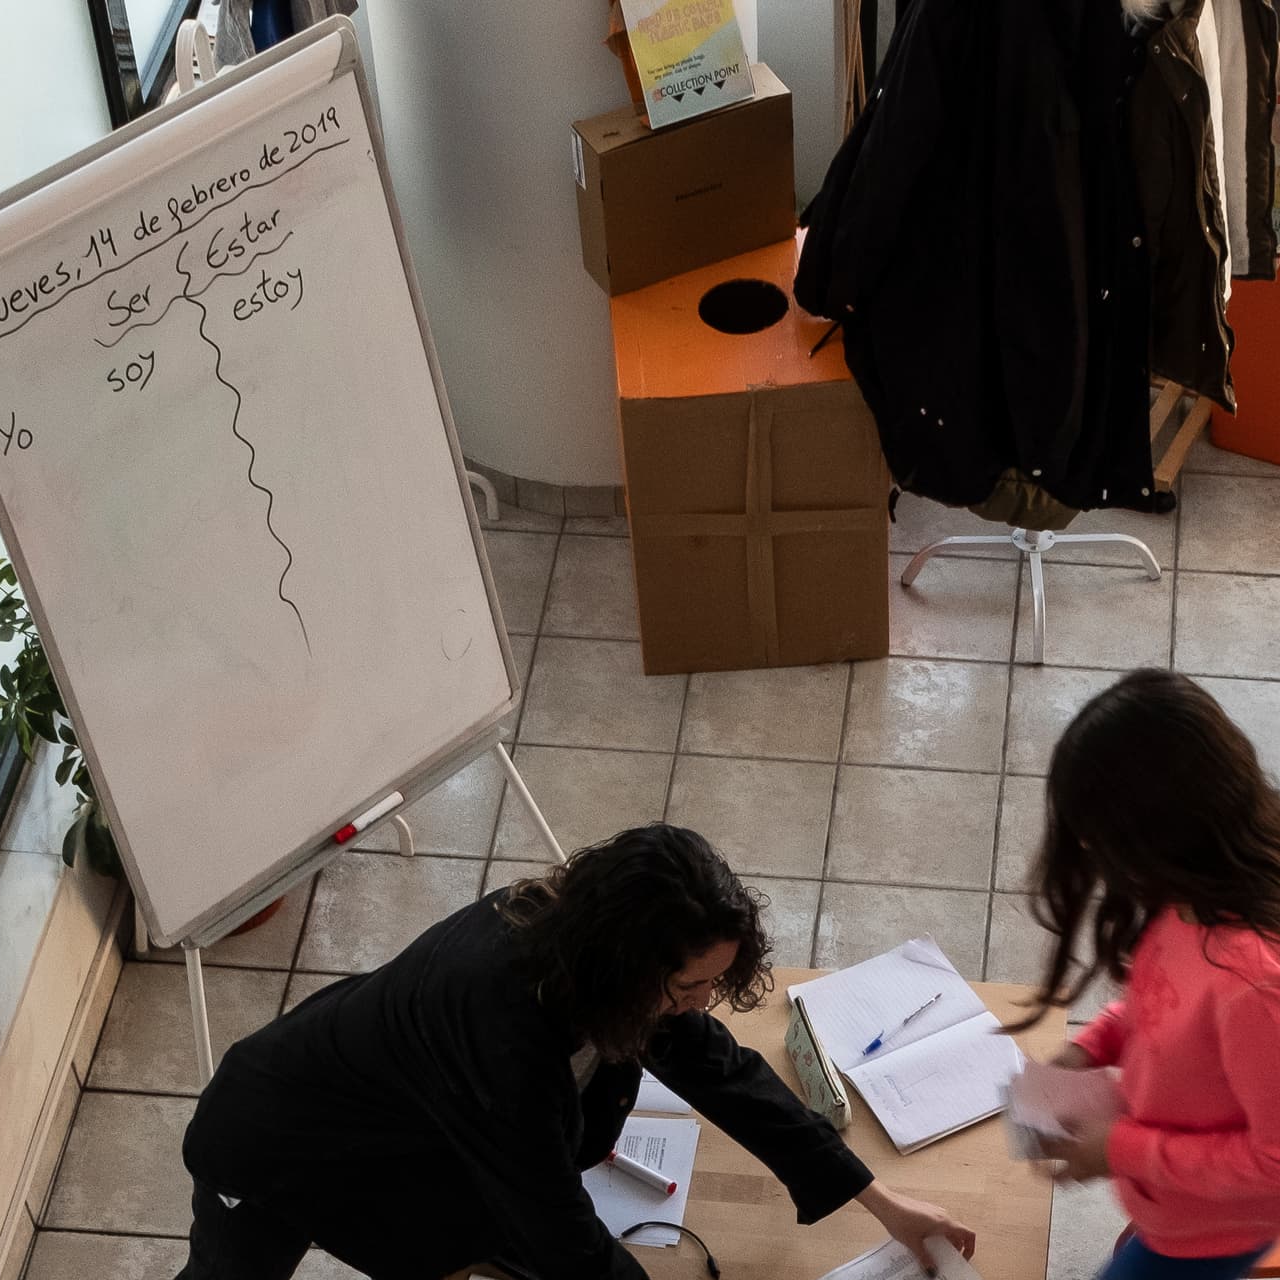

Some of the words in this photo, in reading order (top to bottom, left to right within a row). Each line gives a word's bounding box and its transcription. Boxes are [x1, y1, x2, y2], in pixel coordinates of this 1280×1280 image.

[660, 71, 712, 98] COLLECTION
[714, 64, 740, 80] POINT
[83, 227, 119, 269] 14
[132, 209, 164, 242] de
[166, 166, 251, 234] febrero
[258, 142, 286, 169] de
[286, 105, 342, 154] 2019
[106, 282, 152, 329] Ser
[205, 208, 282, 270] Estar
[106, 349, 157, 392] soy
[232, 264, 306, 323] estoy
